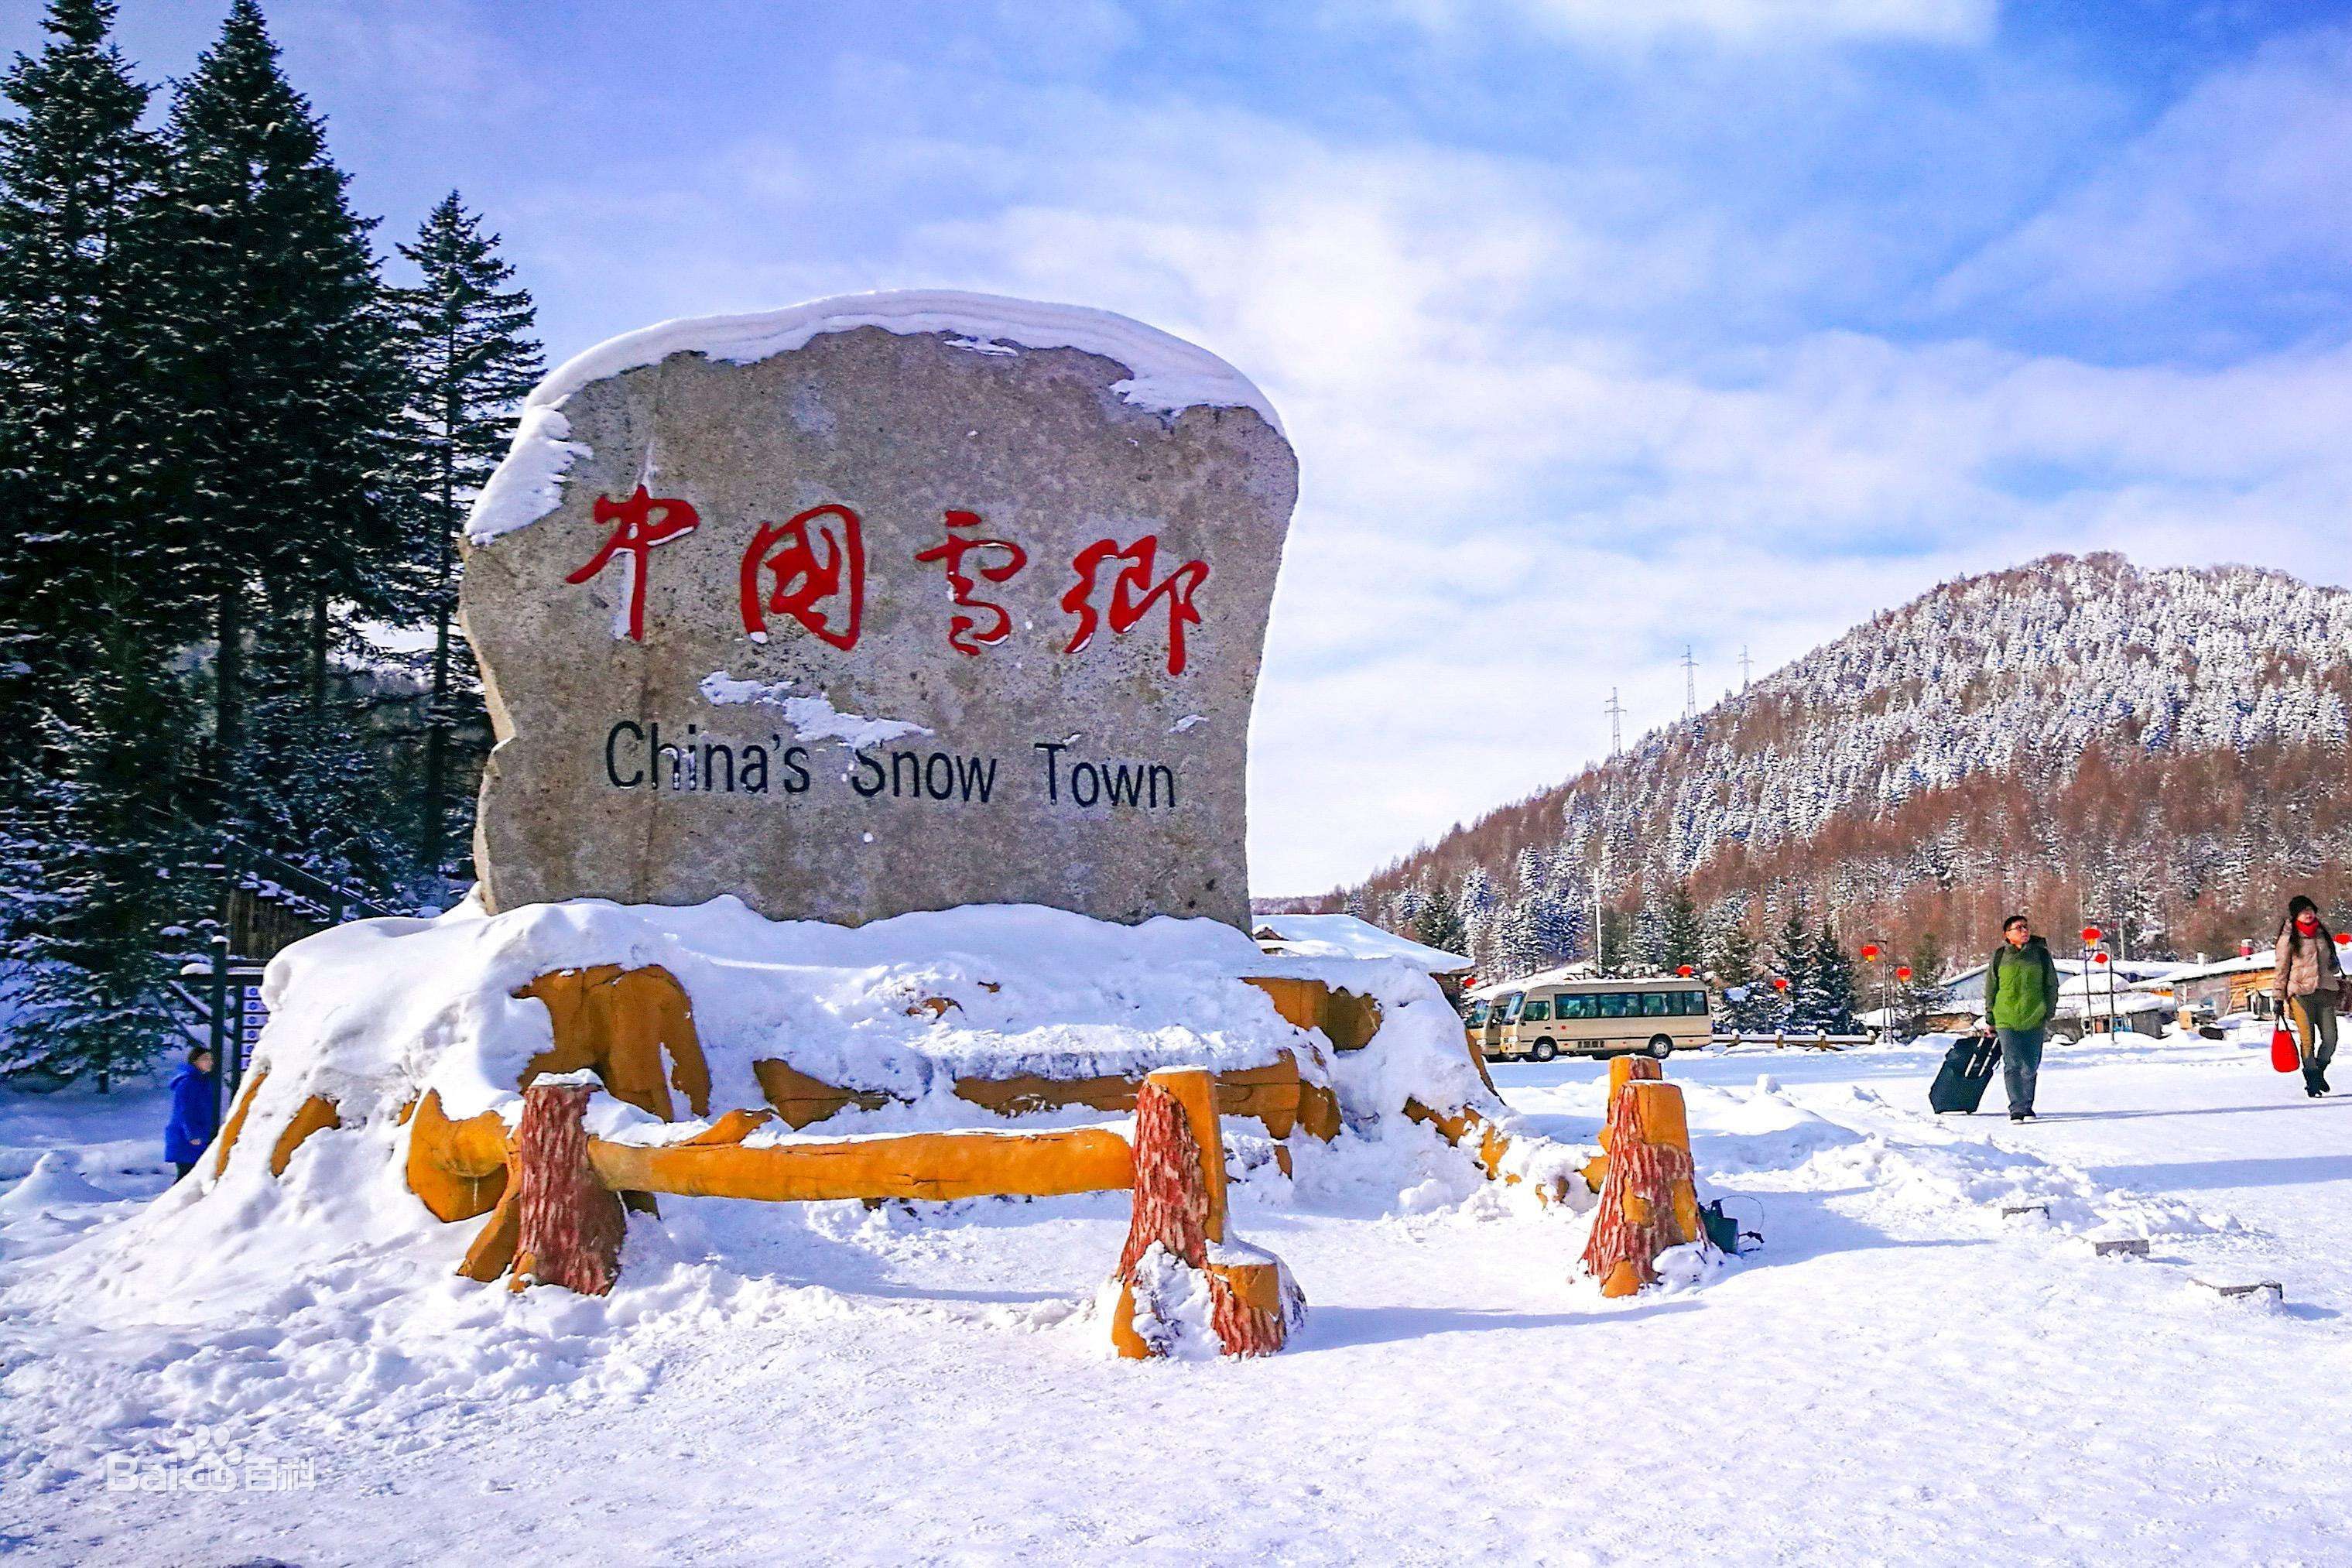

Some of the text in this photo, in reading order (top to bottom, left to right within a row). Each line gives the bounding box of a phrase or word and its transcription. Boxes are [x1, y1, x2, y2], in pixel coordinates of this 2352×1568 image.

[606, 721, 1176, 808] China's Snow Town
